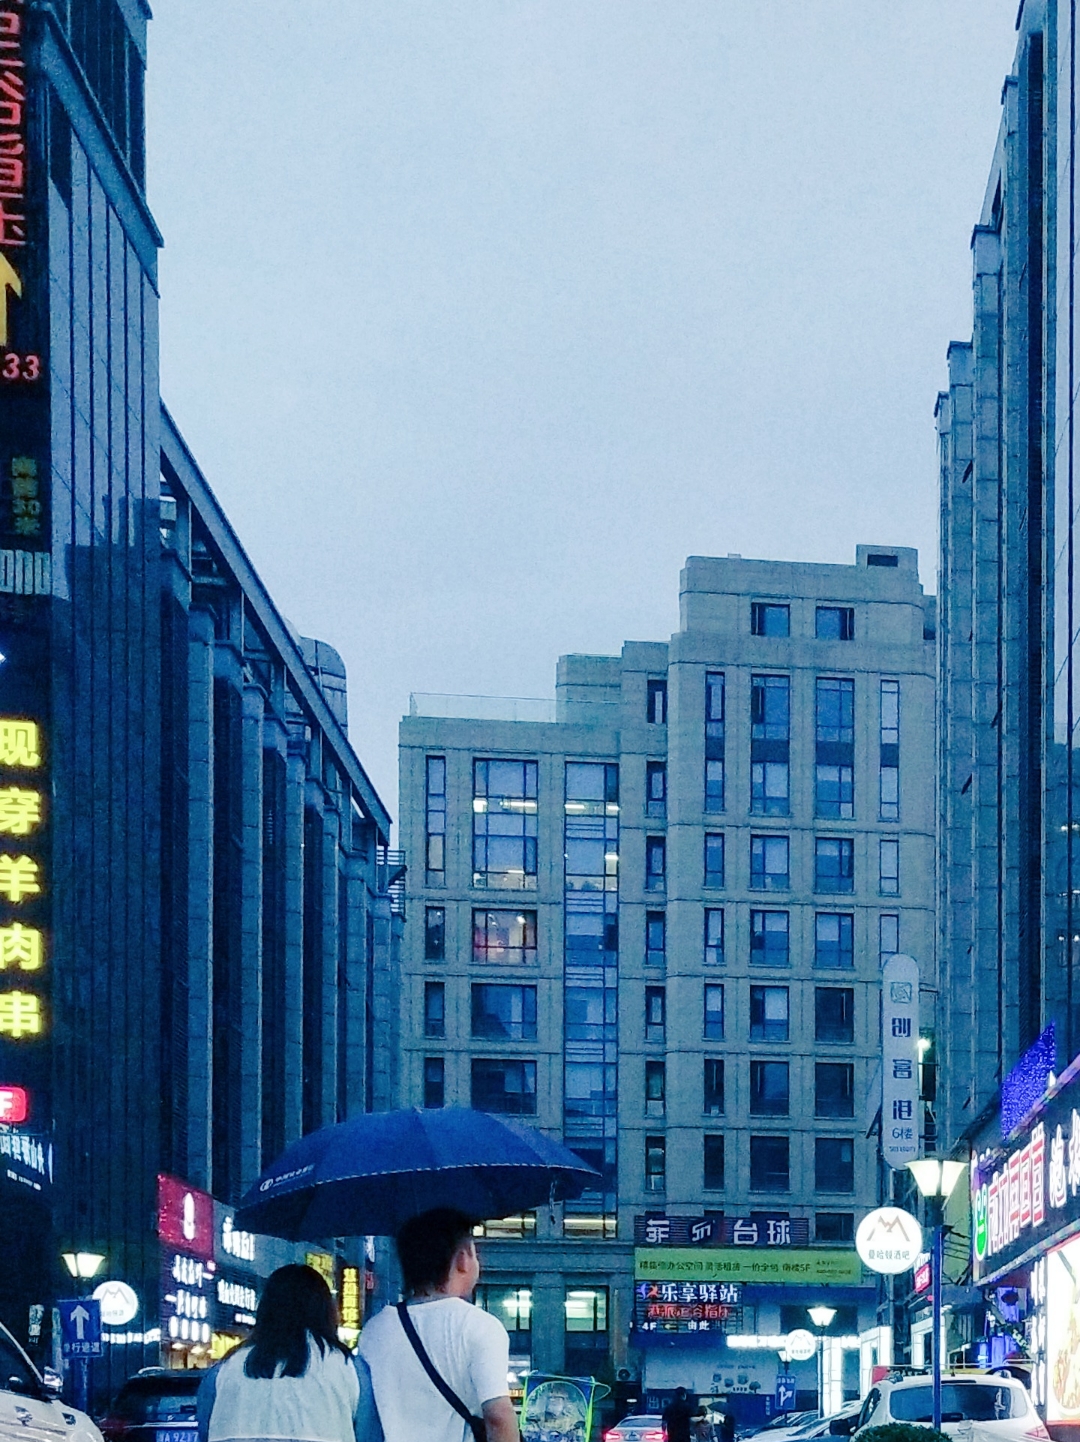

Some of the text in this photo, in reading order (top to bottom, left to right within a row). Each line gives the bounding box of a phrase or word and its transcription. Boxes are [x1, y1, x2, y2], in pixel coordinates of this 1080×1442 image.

[733, 1219, 791, 1245] 台球
[868, 1249, 910, 1260] 曼哈顿酒吧
[661, 1283, 738, 1303] 乐享驿站
